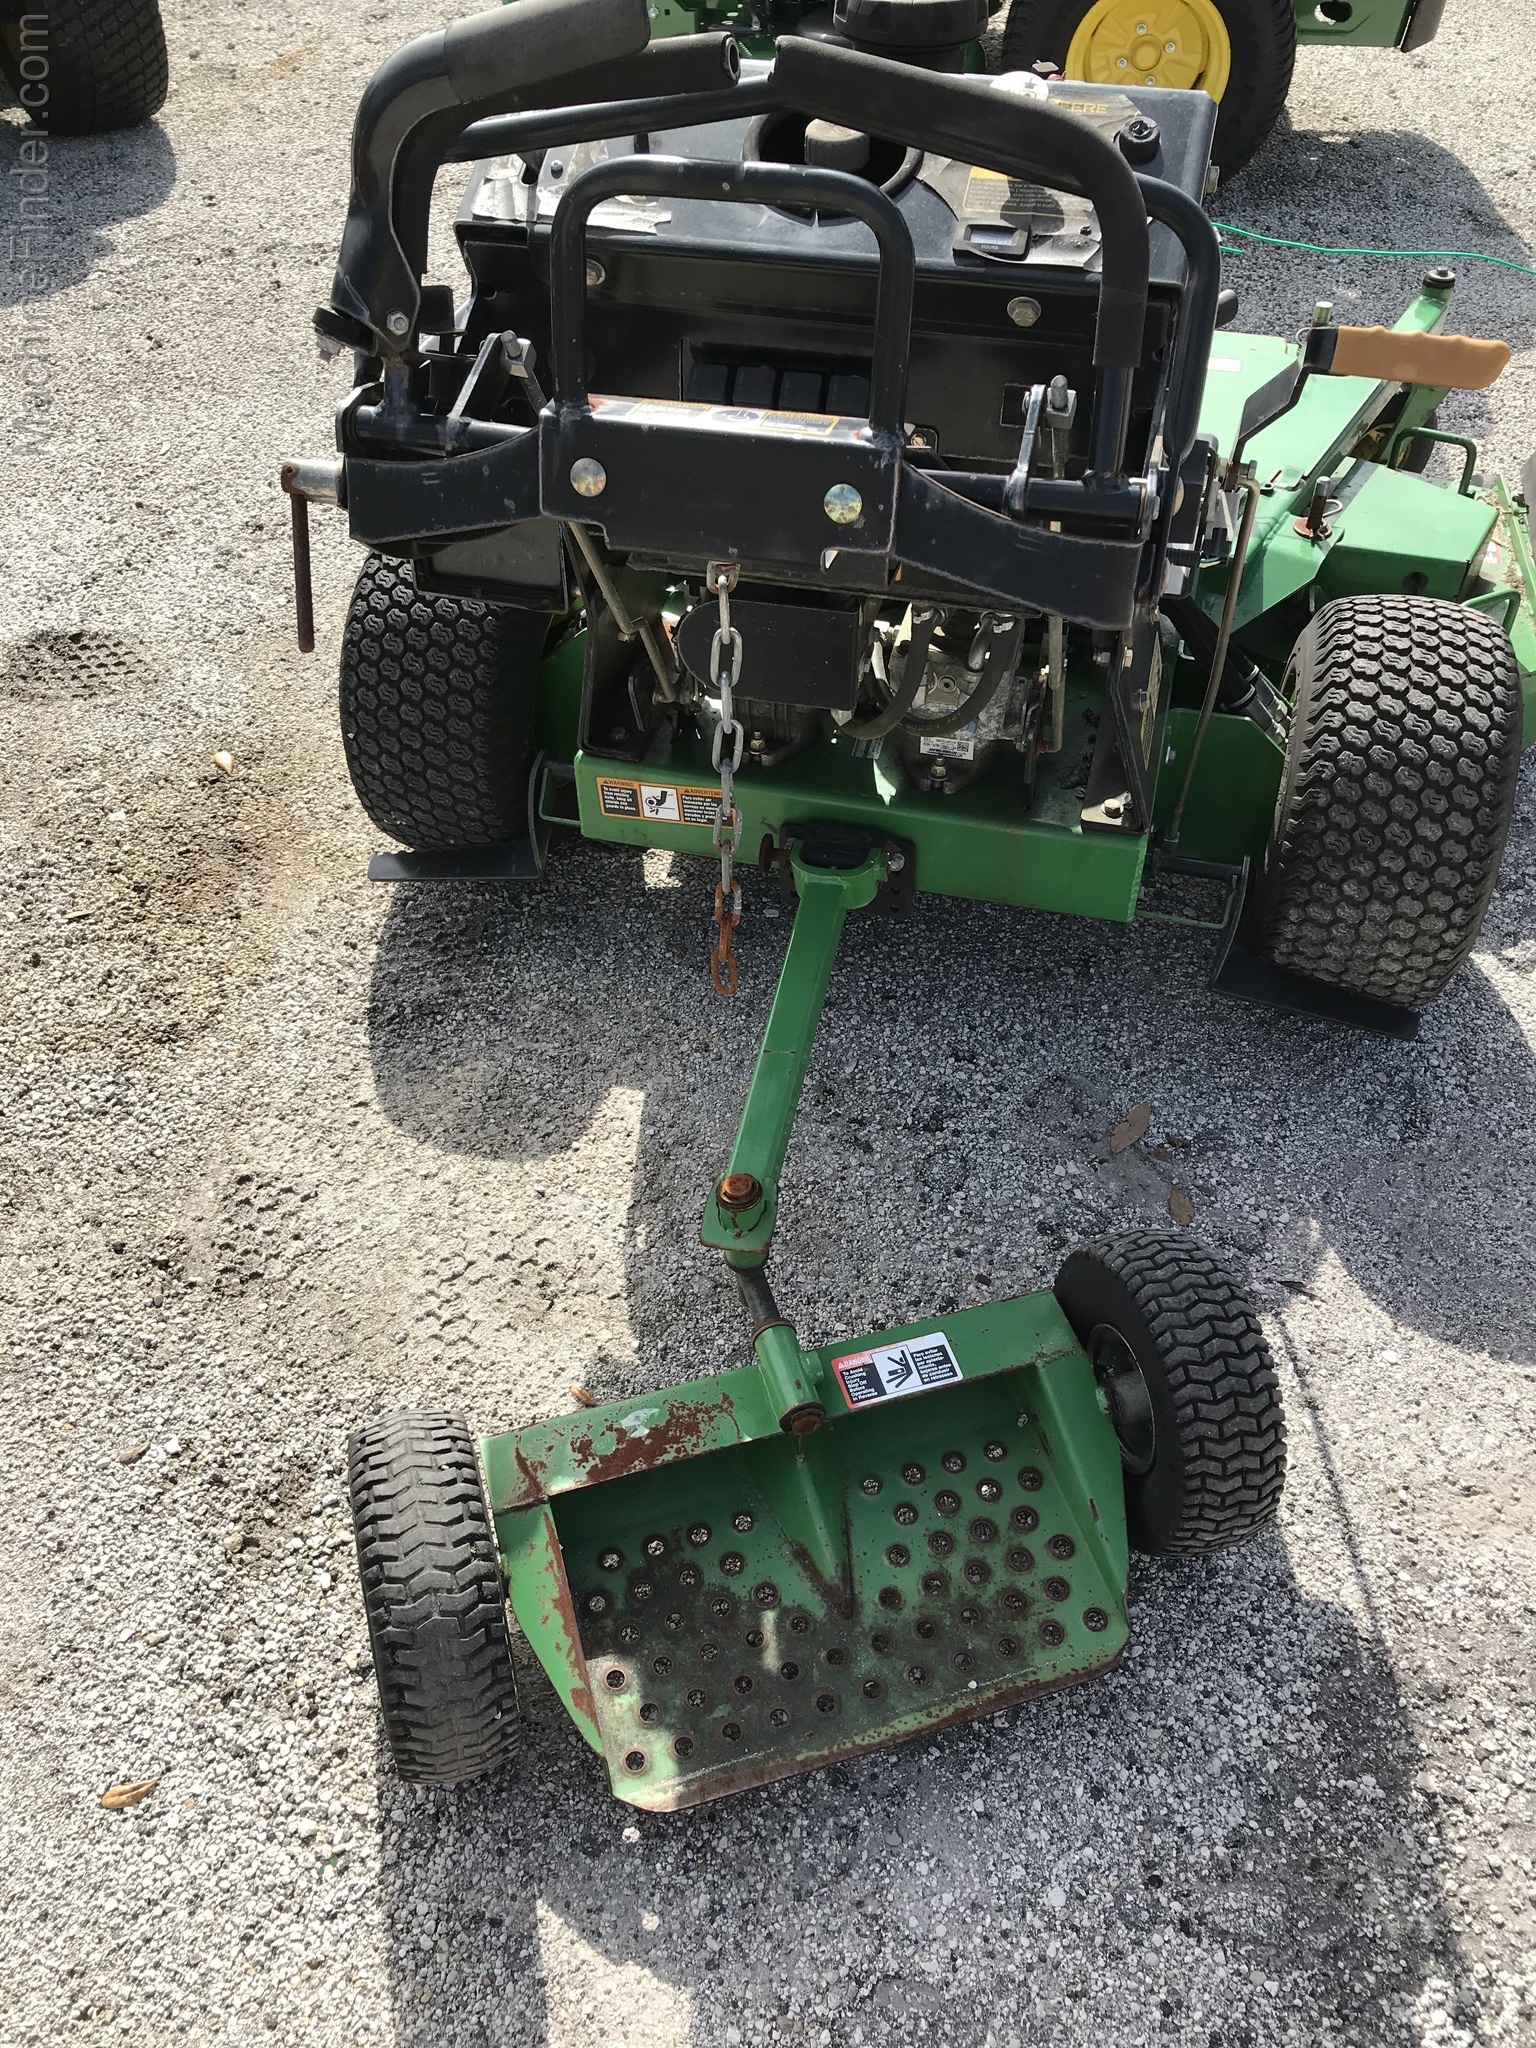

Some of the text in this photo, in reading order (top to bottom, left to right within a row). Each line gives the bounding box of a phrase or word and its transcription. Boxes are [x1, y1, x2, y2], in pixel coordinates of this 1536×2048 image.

[608, 780, 634, 788] WARNING
[922, 1352, 943, 1360] lesiones
[844, 1356, 871, 1367] DANGER
[920, 1367, 938, 1375] bajarse
[928, 1368, 950, 1376] conducir
[844, 1371, 867, 1380] Crushing
[851, 1387, 876, 1397] Operating
[858, 1391, 878, 1399] Reverse
